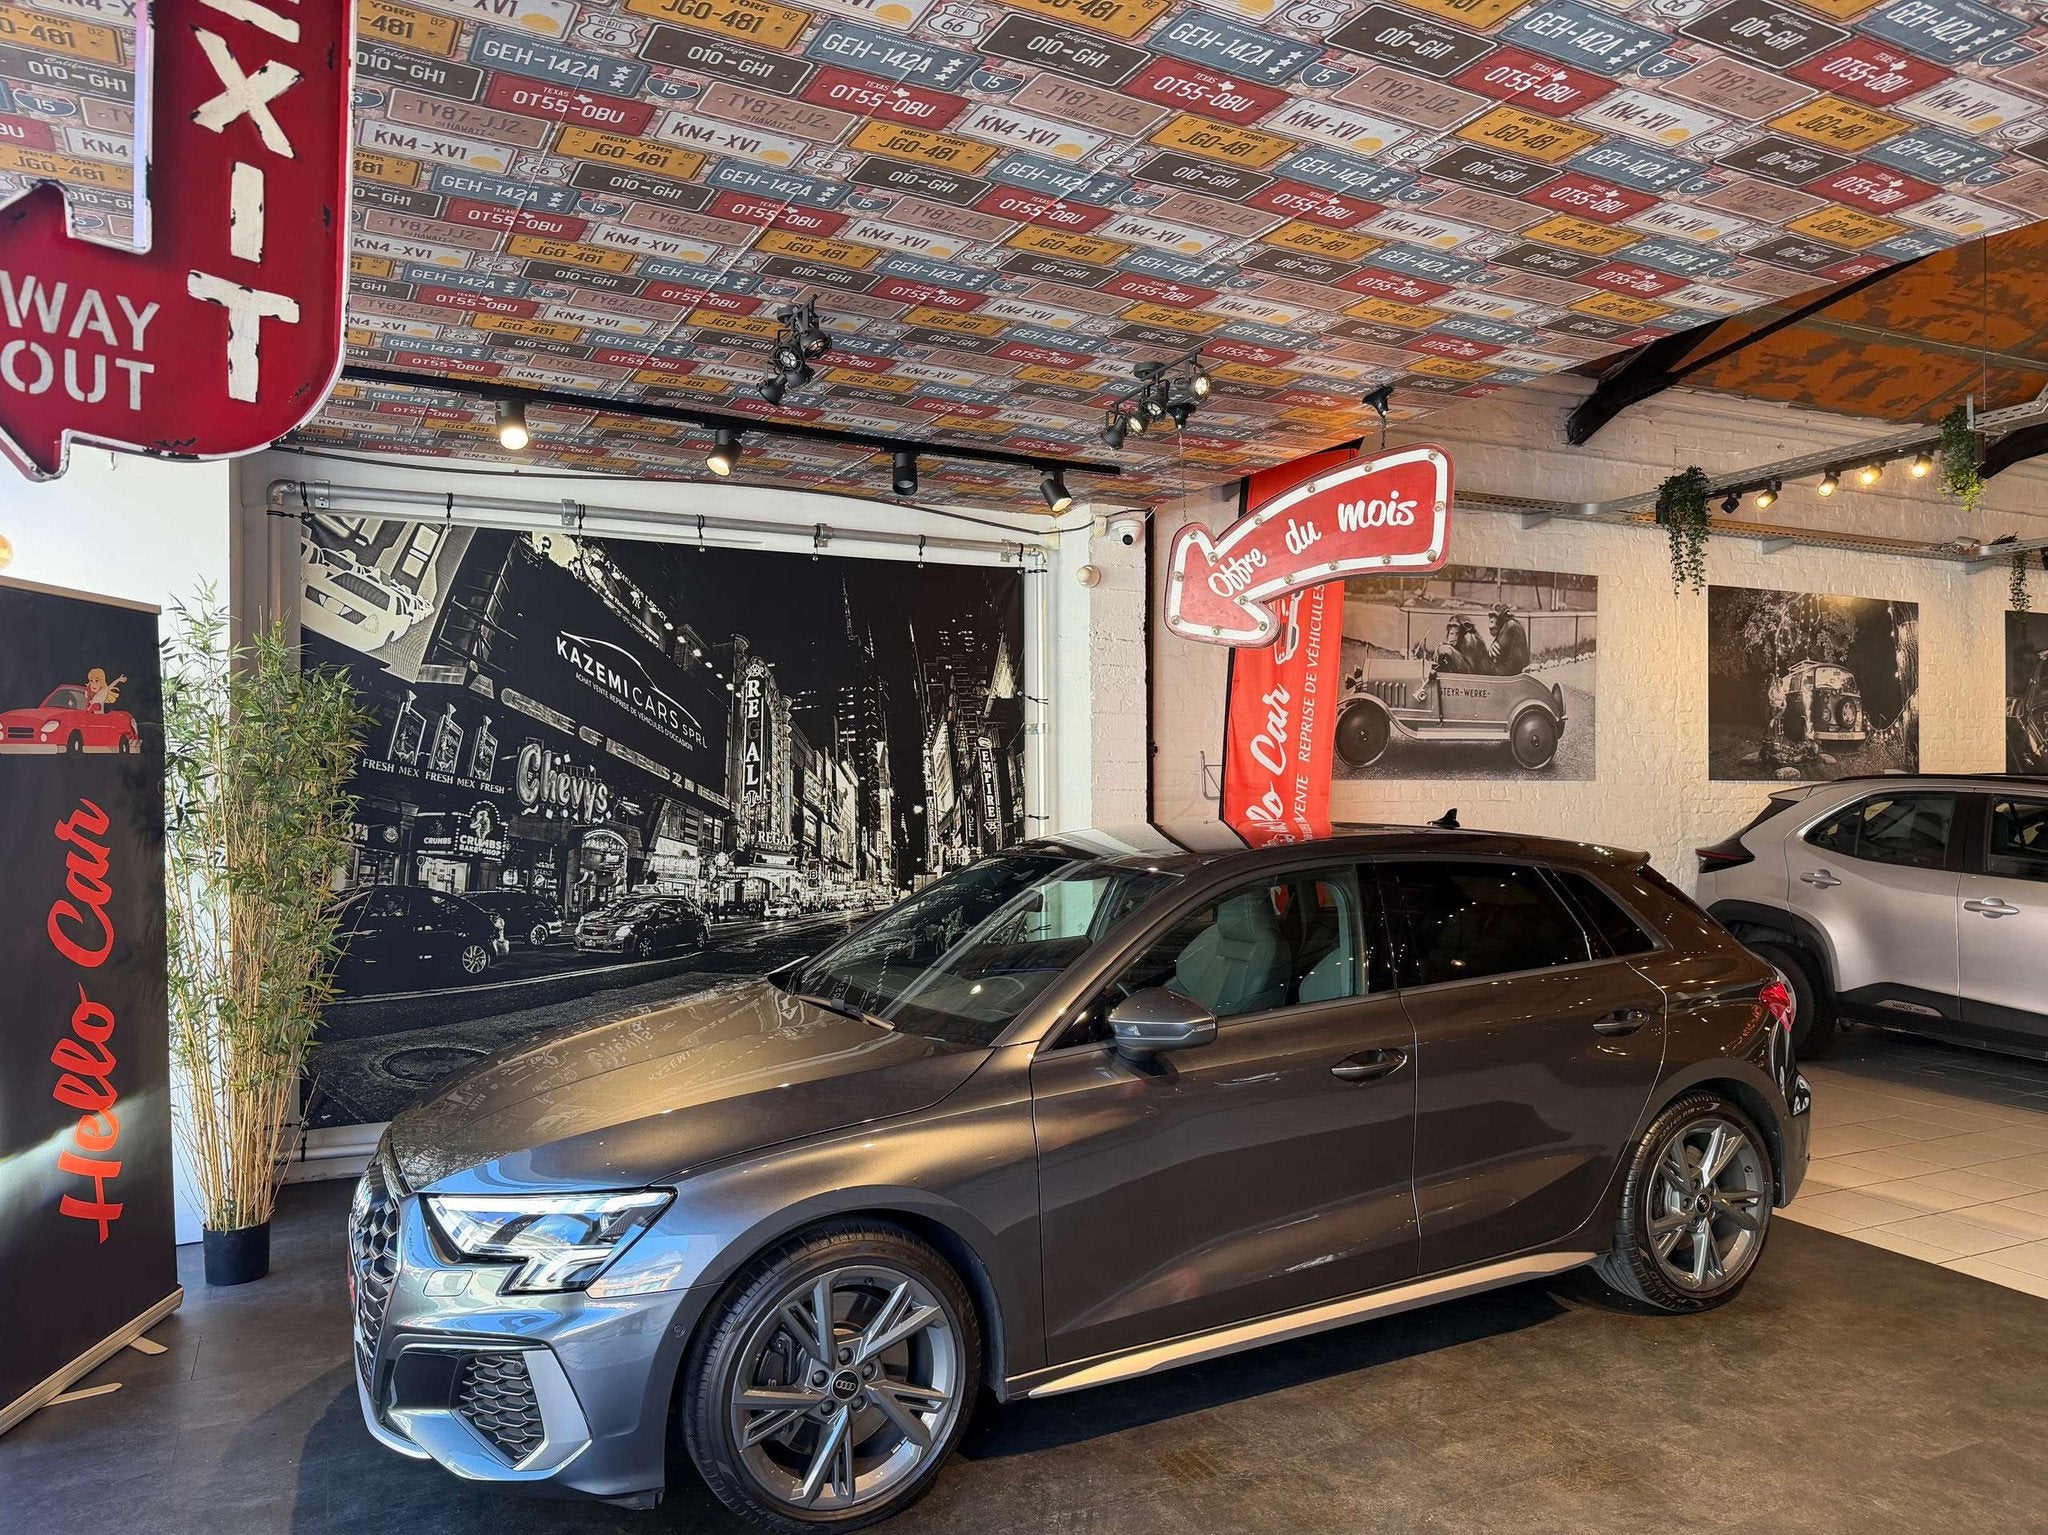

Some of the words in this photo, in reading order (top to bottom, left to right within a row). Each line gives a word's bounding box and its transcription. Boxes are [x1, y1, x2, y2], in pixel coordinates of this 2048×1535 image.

[821, 32, 932, 74] GEH-142A
[1168, 23, 1274, 65] GEH-142A
[482, 40, 599, 80] GEH-142A
[1311, 67, 1342, 81] 15
[1529, 62, 1554, 74] TEXAS
[1647, 58, 1683, 72] 15
[660, 81, 684, 95] 15
[982, 74, 1009, 88] 15
[35, 98, 56, 112] 15
[935, 134, 974, 147] YORK
[1237, 129, 1276, 142] YORK
[1545, 122, 1585, 135] YORK
[638, 140, 678, 153] YORK
[718, 168, 812, 196] GEH-142A
[1002, 162, 1092, 191] GEH-142A
[1291, 157, 1377, 186] GEH-142A
[440, 174, 538, 202] GEH-142A
[0, 269, 160, 351] WAY
[1, 340, 155, 411] OUT
[1284, 518, 1323, 555] du
[1337, 490, 1418, 534] mois
[575, 672, 592, 687] ACHAT
[592, 681, 609, 699] VENTE
[630, 706, 638, 716] DE
[1304, 671, 1317, 695] DE
[682, 723, 708, 749] SPRL
[746, 679, 762, 786] REGAL
[1251, 683, 1290, 776] Car
[1298, 696, 1315, 762] REPRISE
[363, 758, 395, 773] FRESH
[399, 766, 420, 778] MEX
[425, 771, 453, 784] FRESH
[457, 778, 476, 788] MEX
[480, 782, 505, 794] FRESH
[517, 743, 608, 824] Chevys
[981, 750, 997, 819] EMPIRE
[1293, 774, 1309, 823] VENTE
[459, 834, 502, 850] CRUMBS
[46, 797, 114, 967] Car
[50, 982, 123, 1242] Hello
